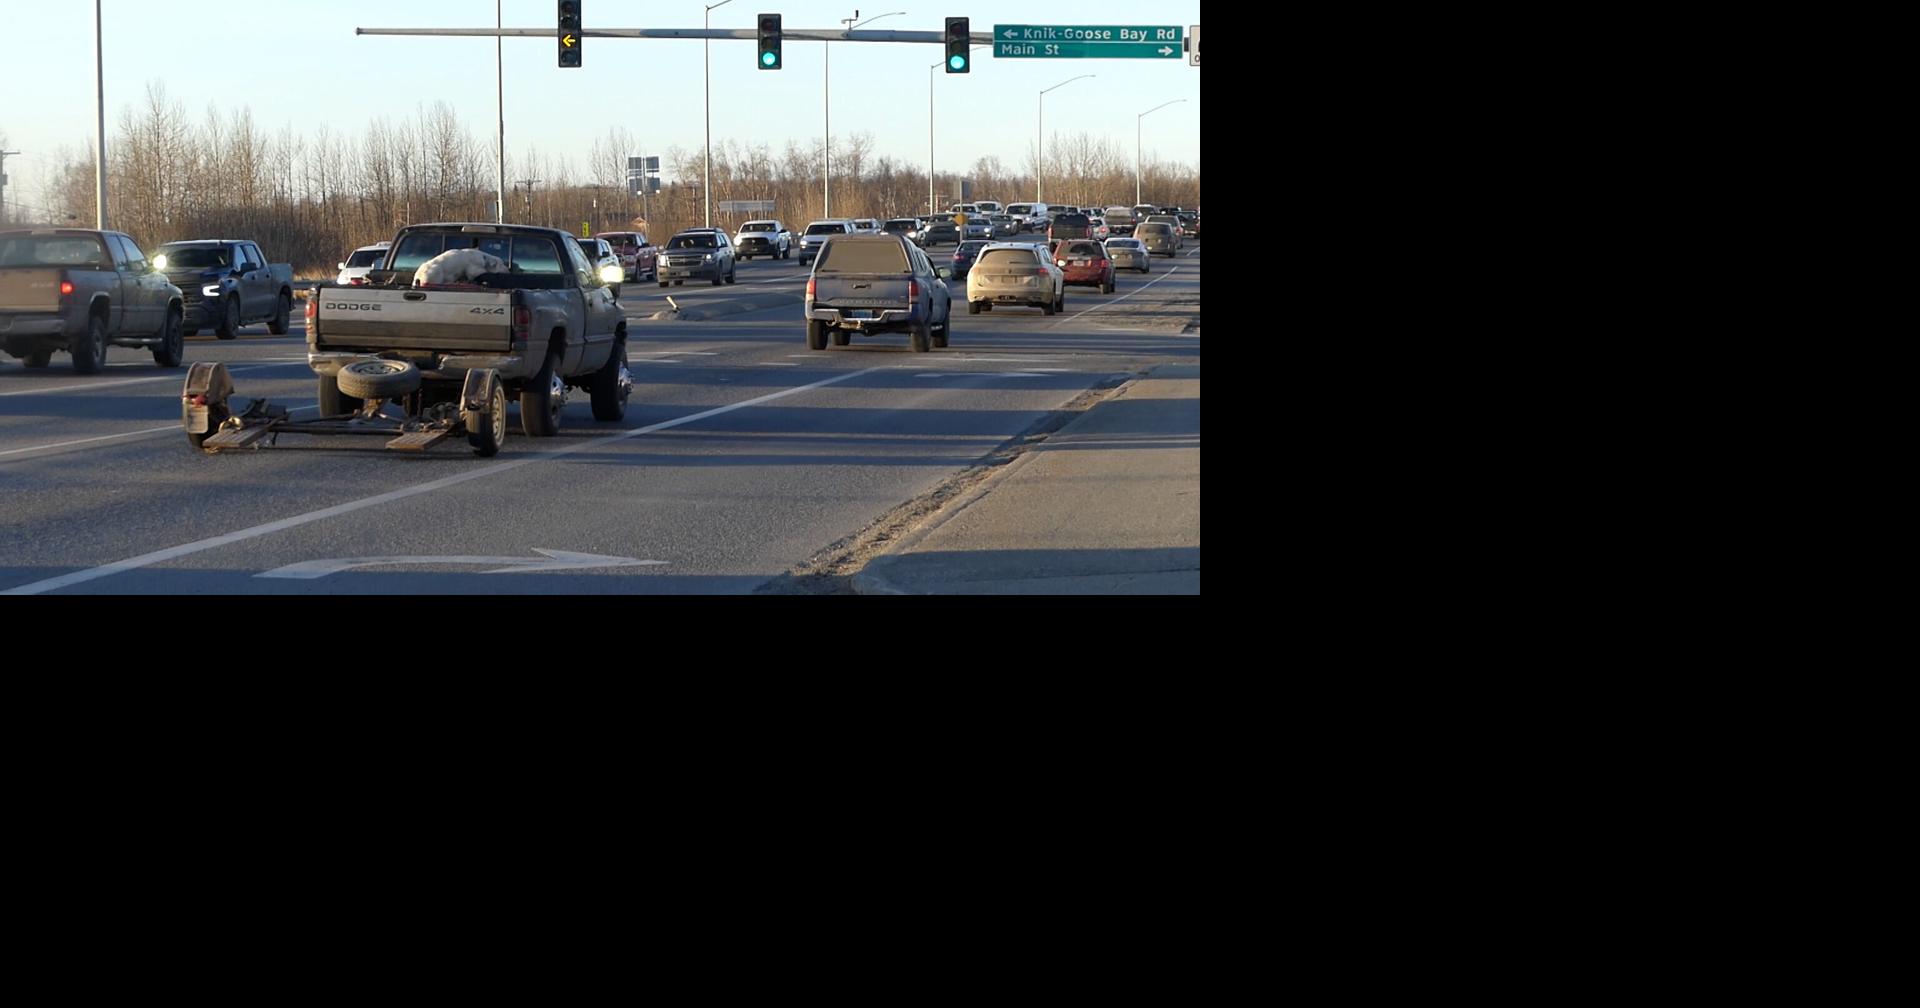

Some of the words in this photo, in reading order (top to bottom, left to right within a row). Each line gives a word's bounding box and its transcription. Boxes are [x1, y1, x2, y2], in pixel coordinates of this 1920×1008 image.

[1024, 26, 1112, 40] Knik-Goose
[1119, 28, 1148, 42] Bay
[1156, 28, 1176, 40] Rd
[1001, 44, 1036, 56] Main
[1044, 44, 1061, 56] St
[325, 302, 382, 311] DODGE
